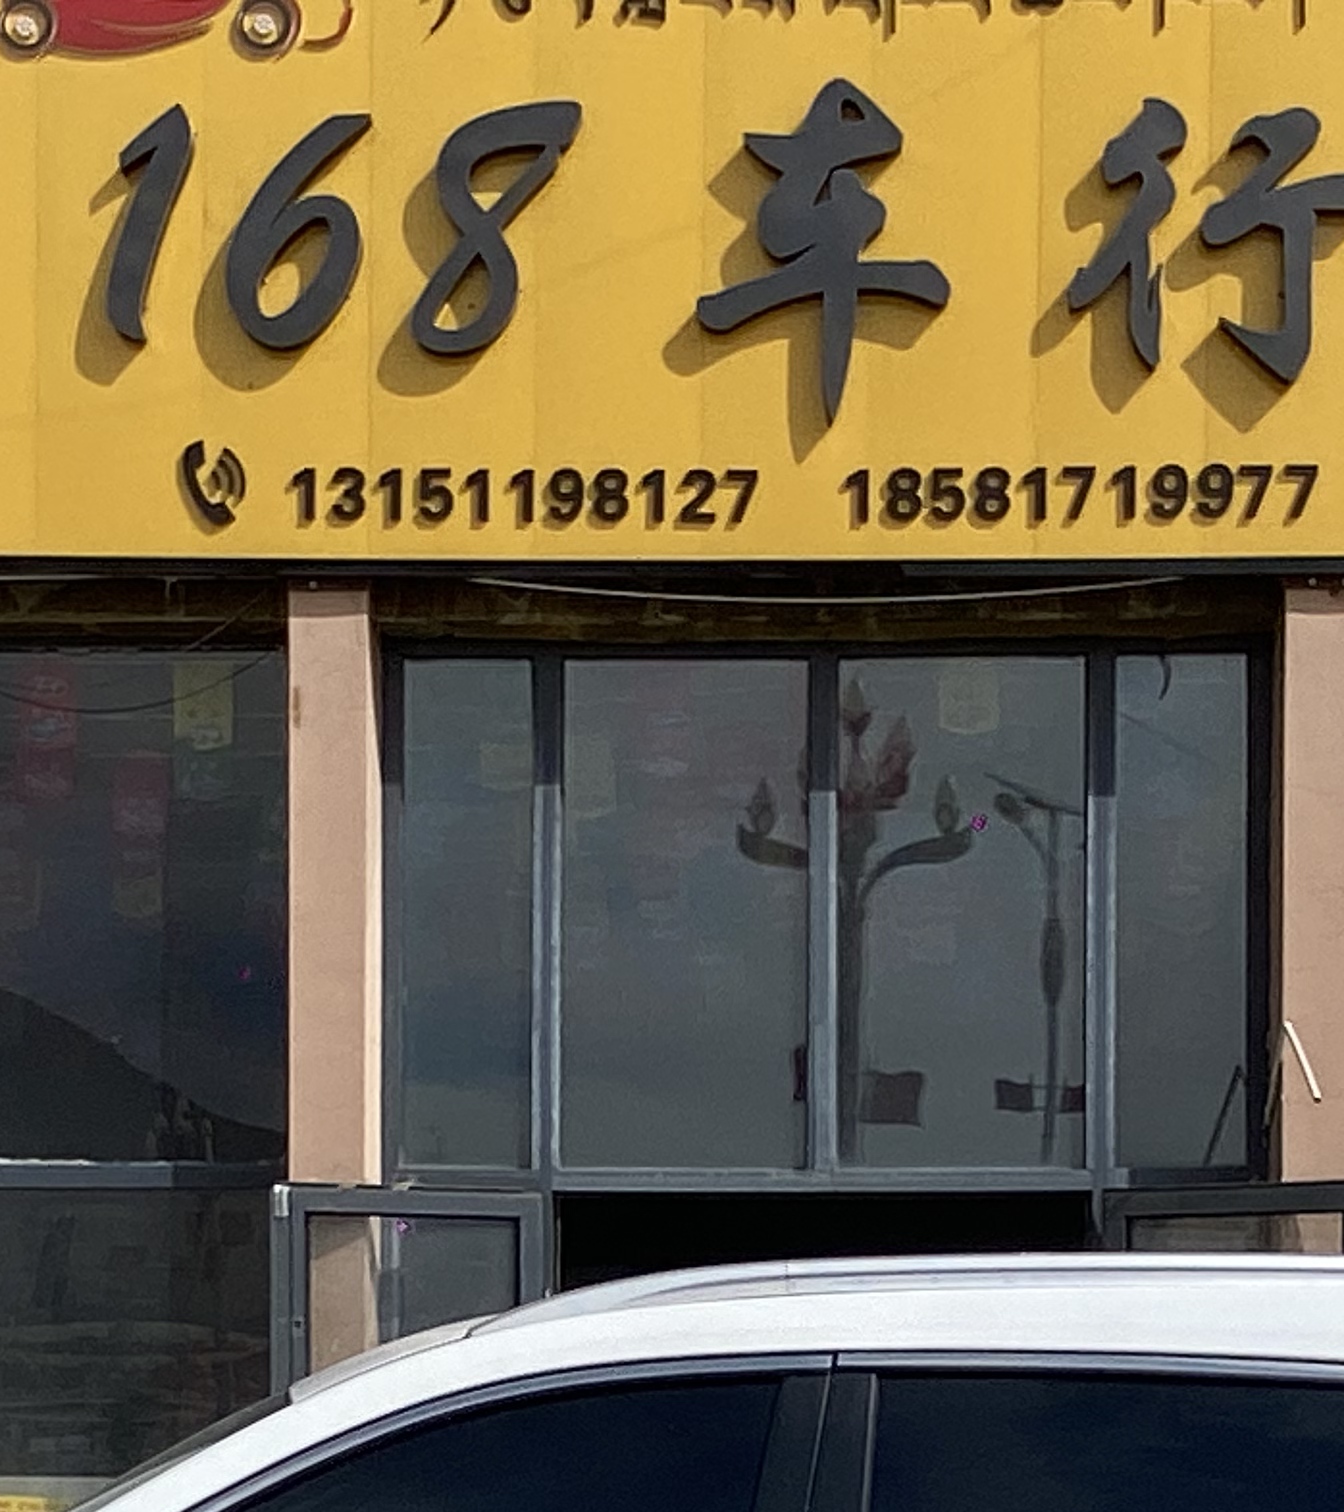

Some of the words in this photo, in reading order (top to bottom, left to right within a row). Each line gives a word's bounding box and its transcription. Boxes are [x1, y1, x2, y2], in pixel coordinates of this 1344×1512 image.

[105, 100, 582, 356] 168
[289, 467, 759, 526] 13151198127
[842, 463, 1319, 526] 18581719977
